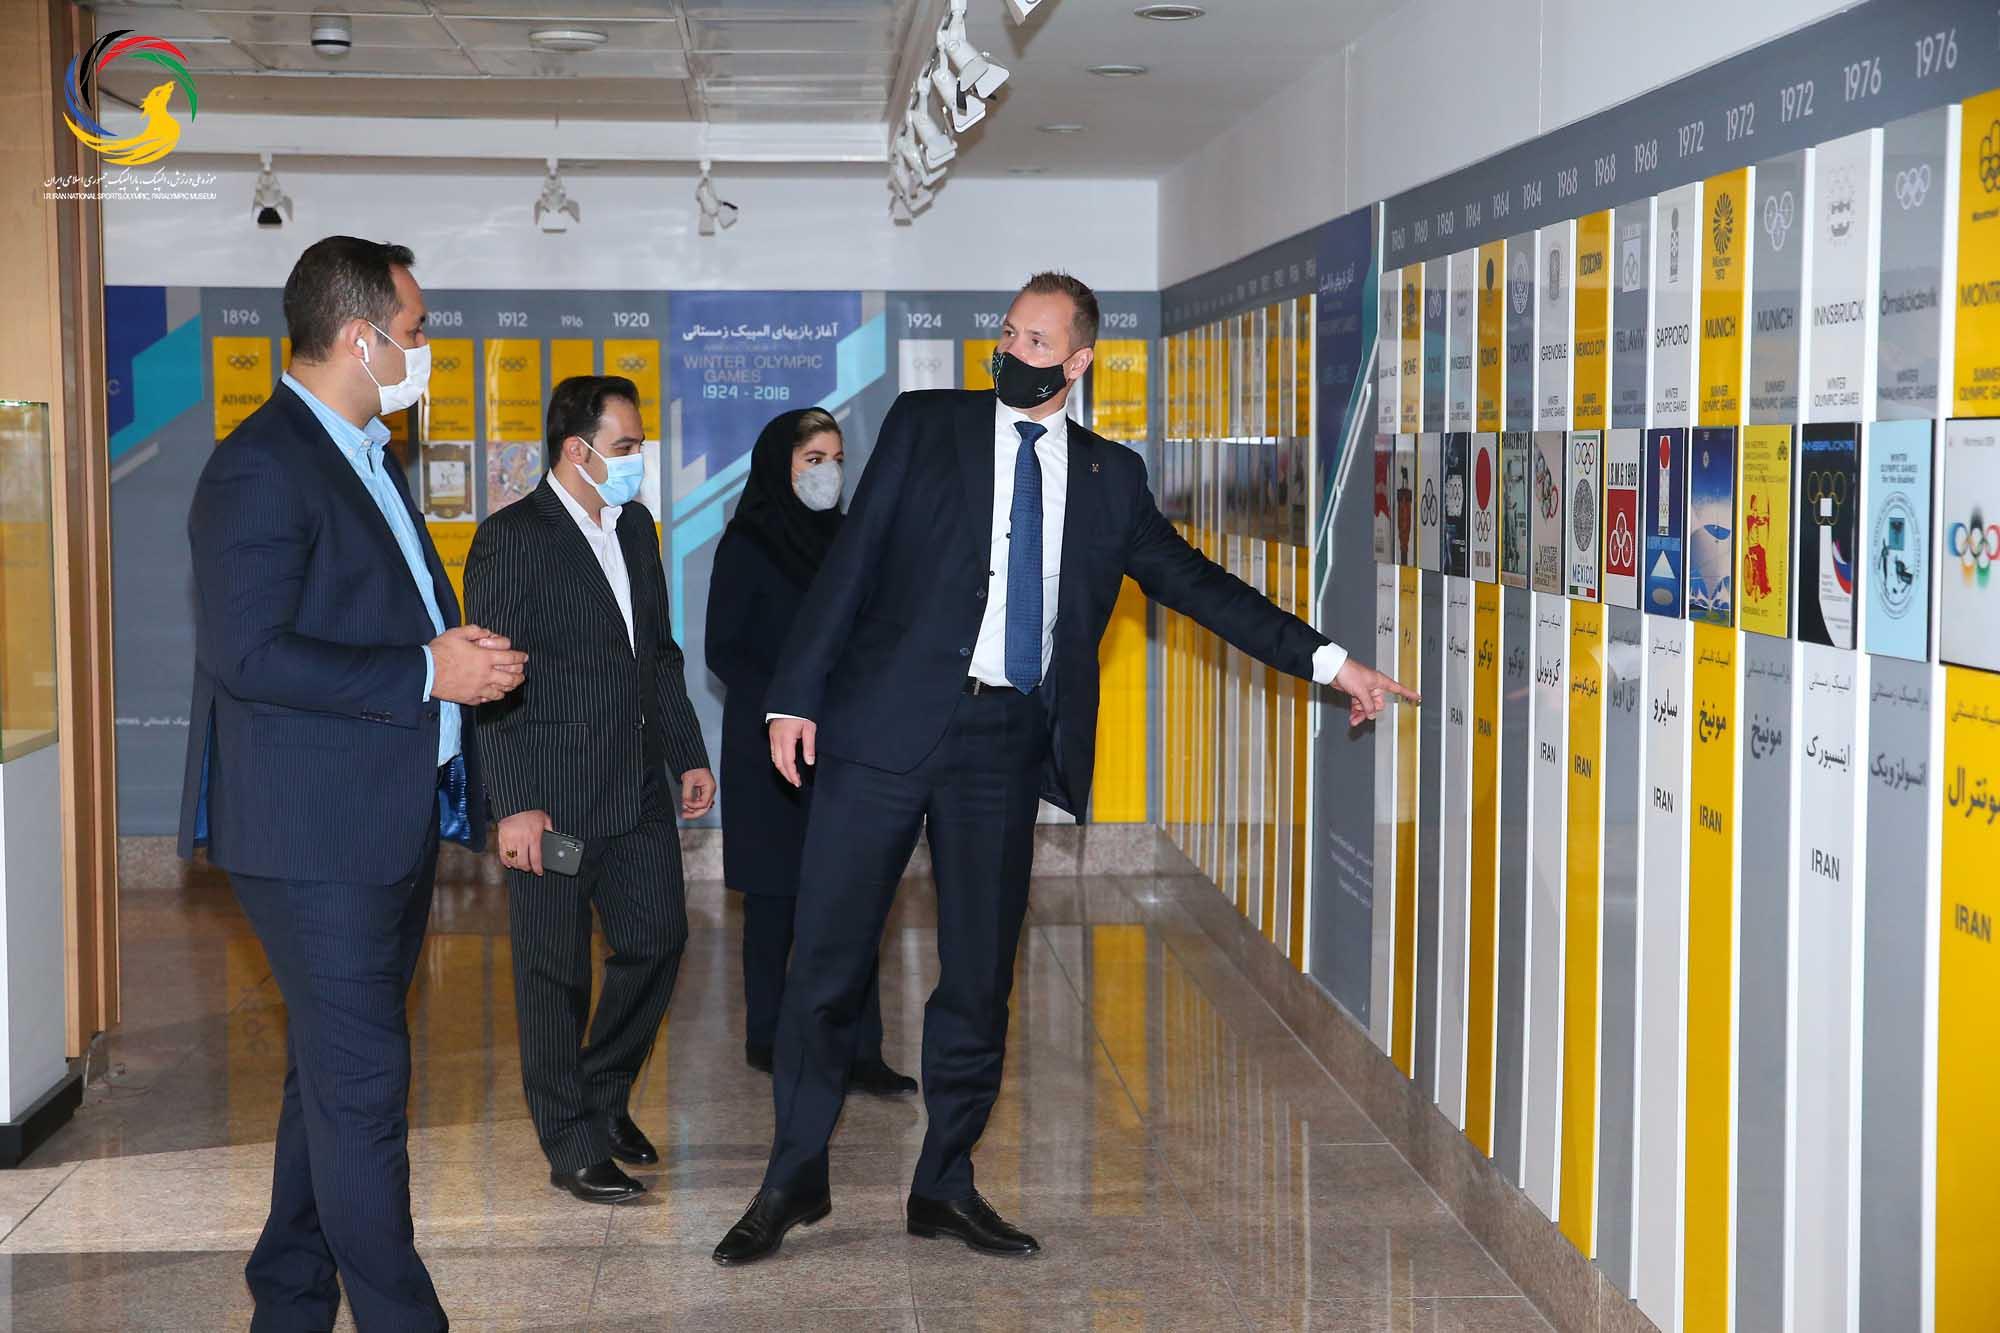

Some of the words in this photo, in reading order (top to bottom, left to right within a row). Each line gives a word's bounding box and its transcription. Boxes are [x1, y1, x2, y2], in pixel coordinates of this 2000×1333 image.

[1915, 29, 1958, 79] 1976
[1843, 56, 1883, 103] 1976
[1780, 80, 1815, 123] 1972
[1726, 101, 1755, 142] 1972
[1678, 120, 1704, 158] 1972
[1634, 138, 1659, 174] 1968
[1594, 152, 1616, 187] 1968
[1523, 180, 1542, 210] 1964
[1557, 167, 1578, 199] 1968
[1465, 202, 1481, 229] 1964
[1493, 192, 1510, 219] 1964
[222, 308, 260, 325] 1896
[427, 311, 463, 328] 1908
[497, 311, 528, 328] 1912
[560, 314, 584, 329] 1916
[612, 311, 650, 329] 1920
[906, 312, 943, 329] 1924
[1103, 312, 1138, 328] 1928
[1757, 308, 1793, 333] MUNICH
[1814, 301, 1865, 327] INNSBRUCK
[682, 323, 729, 341] زمستانی
[730, 324, 770, 341] المپیک
[772, 324, 813, 341] بازیهای
[815, 322, 840, 341] آغاز
[1656, 324, 1690, 348] SAPPORO
[1704, 316, 1736, 339] MUNICH
[683, 354, 746, 369] WINTER
[753, 354, 823, 369] OLYMPIC
[1541, 343, 1567, 361] GRENOBLE
[704, 369, 761, 383] GAMES
[703, 384, 738, 399] 1924
[754, 385, 790, 400] 2018
[1572, 562, 1593, 584] MEXICO
[1450, 708, 1463, 727] IRAN
[1478, 717, 1492, 737] IRAN
[1699, 699, 1727, 743] مونیخ
[1751, 713, 1783, 759] مونیخ
[1540, 742, 1556, 765] IRAN
[1574, 754, 1592, 779] IRAN
[1653, 786, 1674, 813] IRAN
[1699, 804, 1722, 835] IRAN
[1811, 847, 1840, 882] IRAN
[1955, 903, 1992, 943] IRAN
